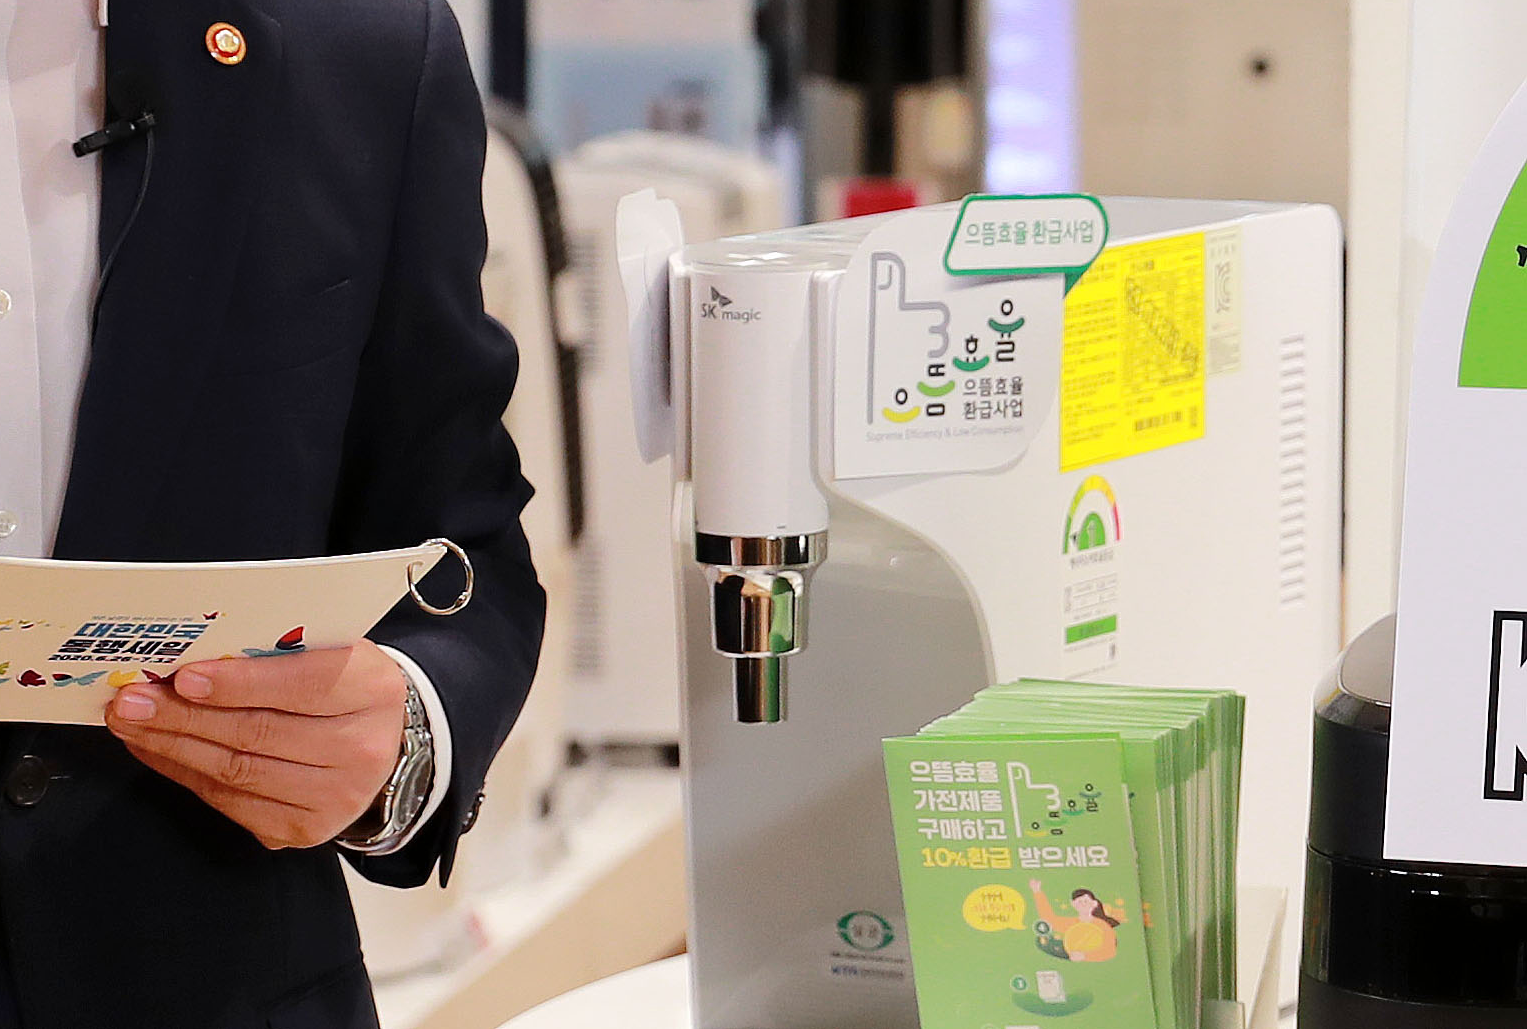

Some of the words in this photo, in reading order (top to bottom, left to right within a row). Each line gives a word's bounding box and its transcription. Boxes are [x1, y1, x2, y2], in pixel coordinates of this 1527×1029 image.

[965, 221, 1028, 246] 으뜸효율
[1032, 220, 1094, 244] 환급사업
[701, 303, 717, 319] SK
[721, 309, 762, 323] magic
[962, 376, 1023, 397] 으뜸효율
[963, 399, 1023, 420] 환급사업
[74, 622, 209, 640] 대한민국
[58, 639, 193, 656] 동행세일
[910, 761, 999, 783] 으뜸효율
[913, 789, 1004, 812] 가전제품
[918, 818, 1008, 841] 구매하고
[1018, 845, 1111, 869] 받으세요
